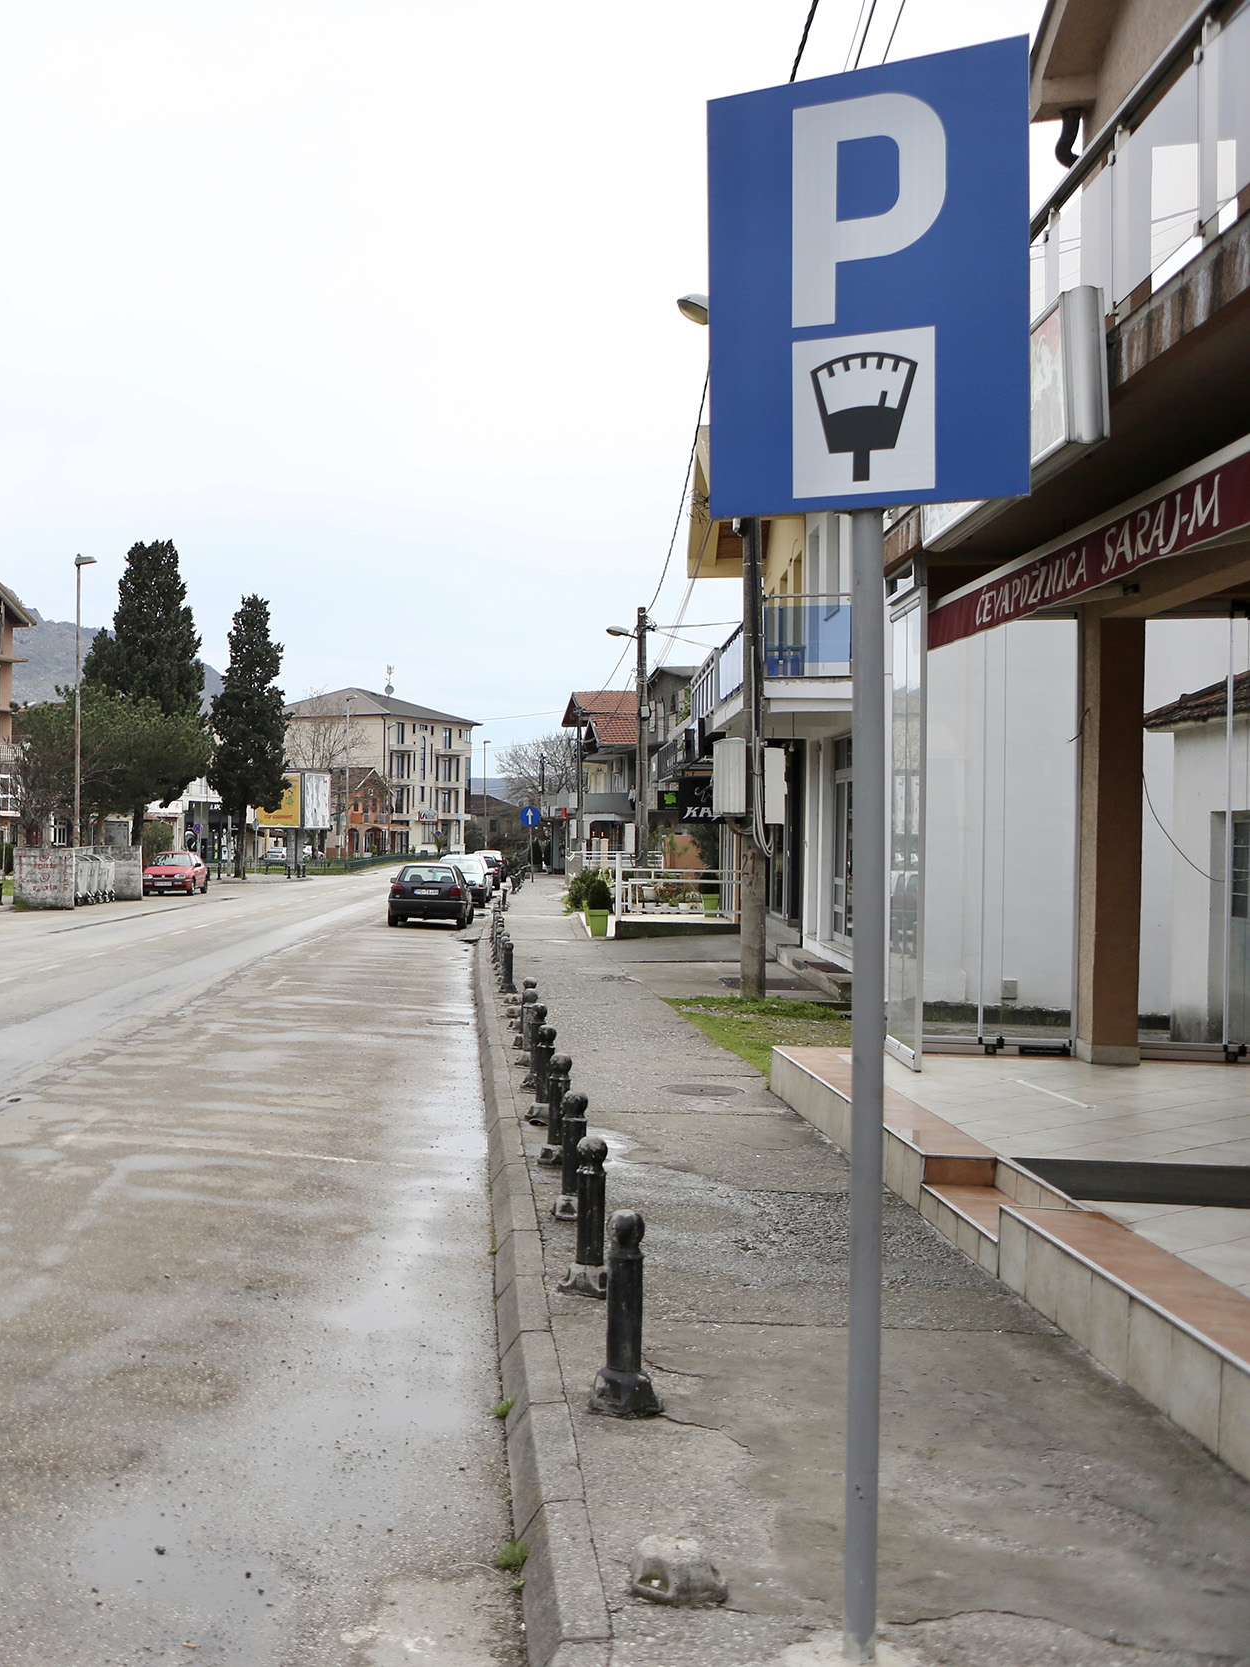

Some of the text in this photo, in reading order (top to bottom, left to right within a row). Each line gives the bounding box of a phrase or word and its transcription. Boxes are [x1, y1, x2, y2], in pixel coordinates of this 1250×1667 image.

[792, 92, 947, 328] P
[1101, 473, 1221, 575] SARAJ-M
[682, 806, 722, 822] KA
[742, 851, 756, 875] 21
